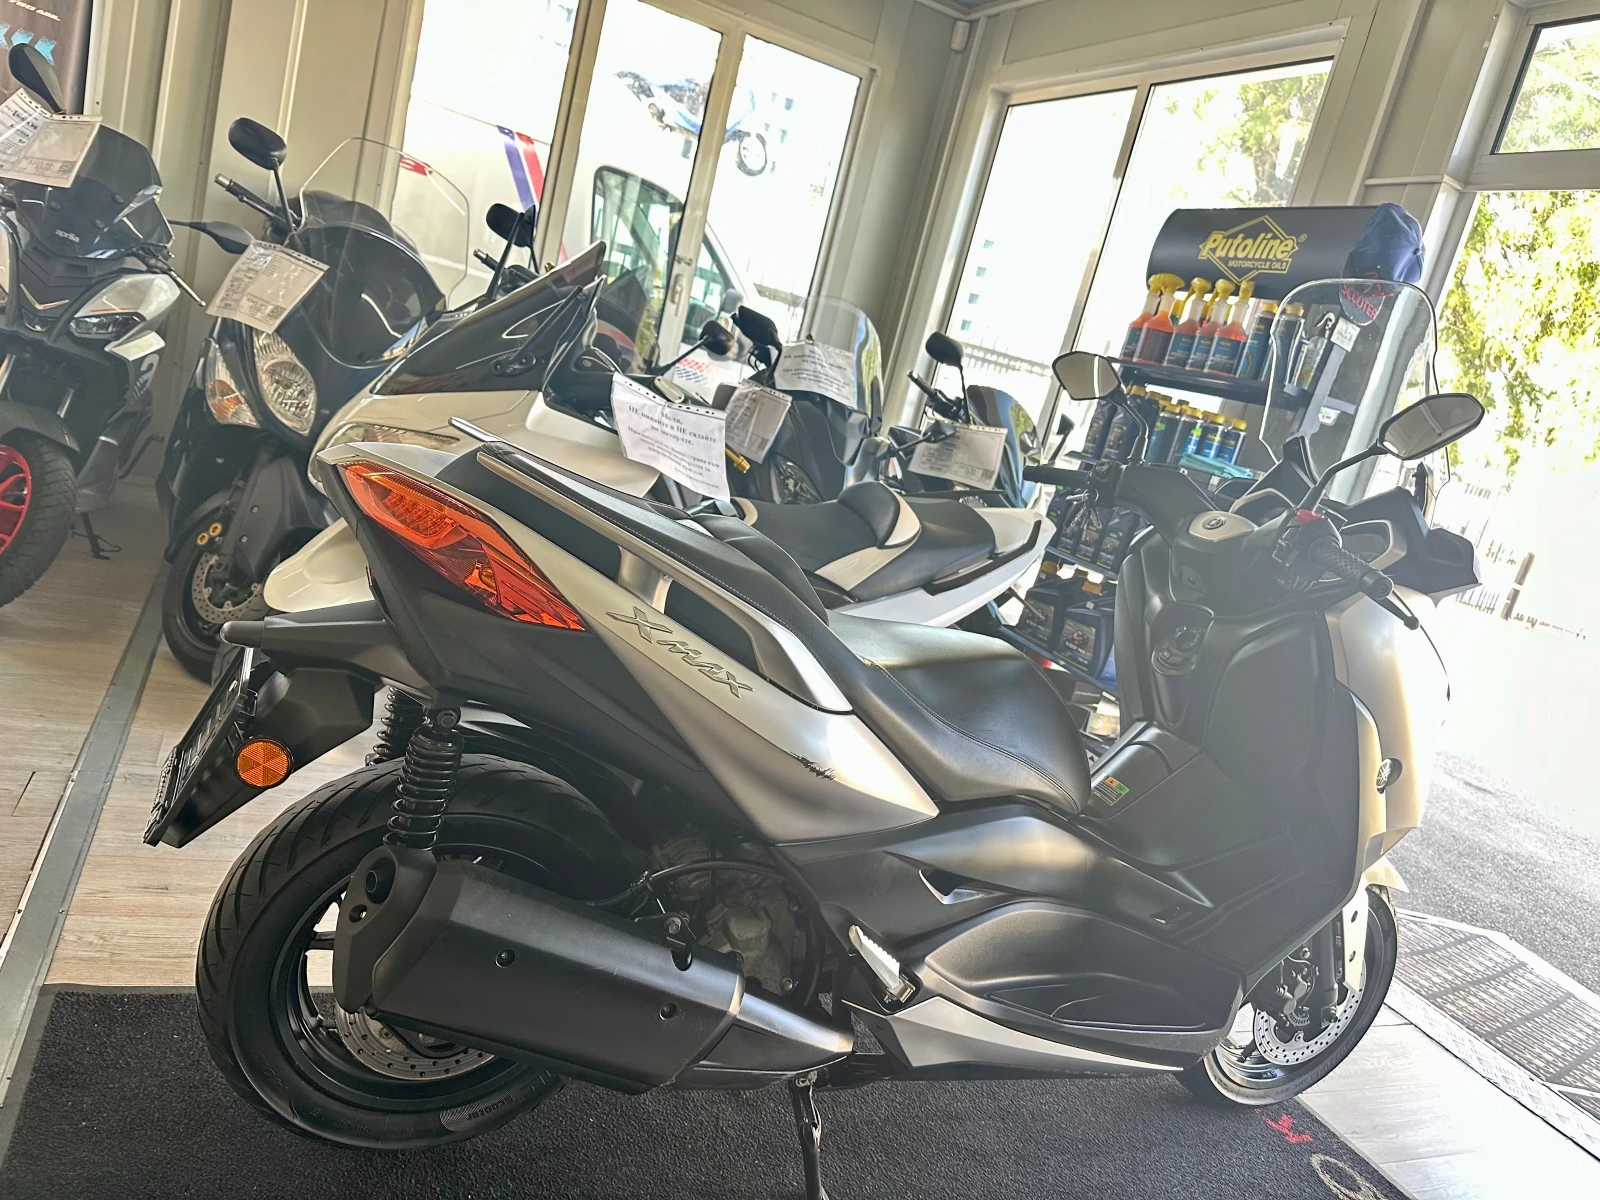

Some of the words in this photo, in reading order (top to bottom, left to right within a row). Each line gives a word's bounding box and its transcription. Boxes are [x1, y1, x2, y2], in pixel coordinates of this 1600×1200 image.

[1201, 231, 1294, 259] Putoline
[1228, 259, 1270, 269] MOTORCYCLE
[1271, 261, 1287, 270] OILS
